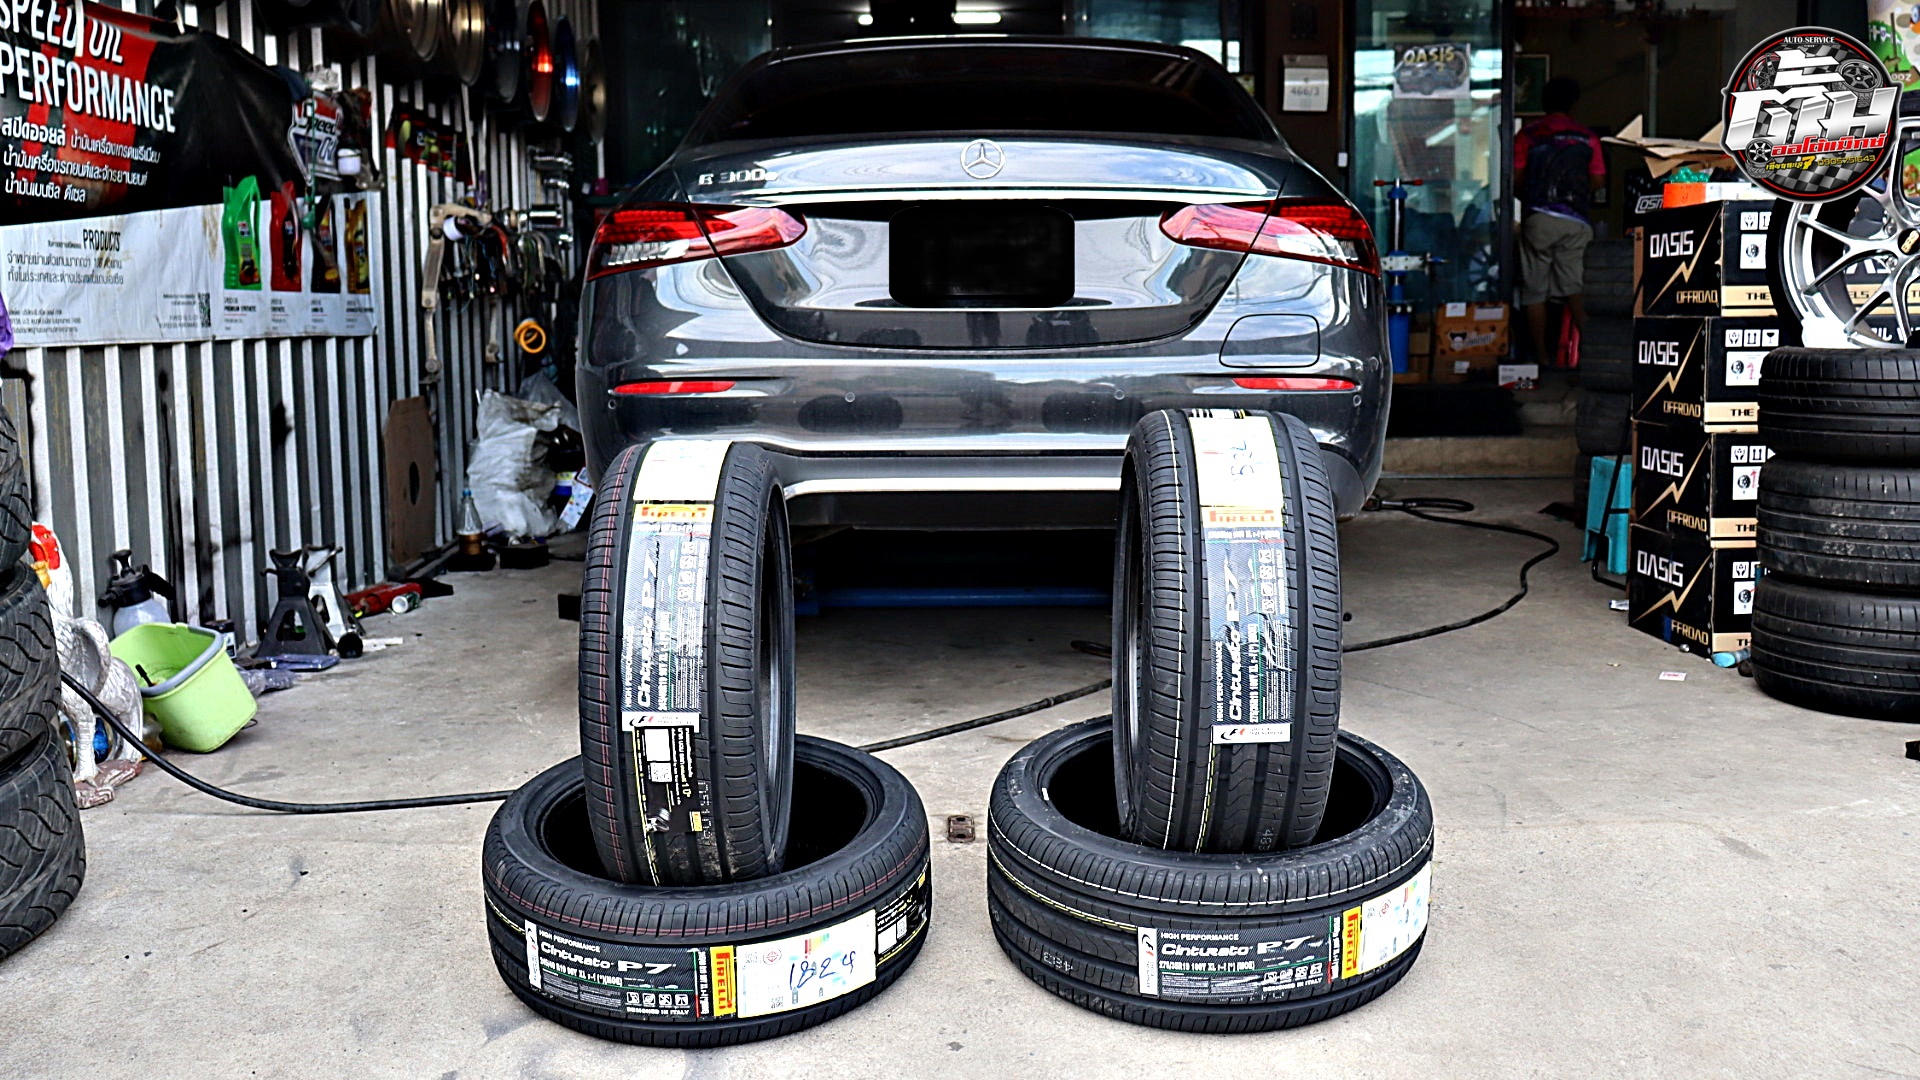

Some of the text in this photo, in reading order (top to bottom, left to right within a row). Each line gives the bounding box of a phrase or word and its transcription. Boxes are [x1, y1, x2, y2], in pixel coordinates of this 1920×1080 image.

[1403, 46, 1455, 65] OASIS
[0, 41, 175, 133] PERFORMANCE
[82, 228, 121, 252] PRODUCTS
[1650, 230, 1694, 258] OASIS
[1676, 289, 1718, 304] OFFROAD
[1745, 292, 1770, 301] THE
[1638, 341, 1679, 366] OASIS
[1663, 400, 1701, 418] OFFROAD
[1730, 408, 1754, 417] THE
[1641, 446, 1683, 477] OASIS
[1209, 509, 1274, 523] PIRELLI
[1667, 509, 1707, 533] OFFROAD
[1637, 550, 1683, 587] OASIS
[1224, 554, 1242, 721] Cinturato P7
[1664, 617, 1709, 646] FFROAD
[1215, 641, 1224, 722] HIGH PERFORMANCE
[538, 929, 601, 953] HIGH PERFORMANCE
[1160, 933, 1239, 941] HIGH PERFORMANCE
[1161, 935, 1315, 957] Cinturato P7
[1346, 912, 1359, 971] PIRELLI
[540, 941, 675, 975] Cinturato P7
[716, 951, 732, 1010] PIRELLI
[789, 950, 857, 991] 1824
[1305, 976, 1323, 987] ITALY
